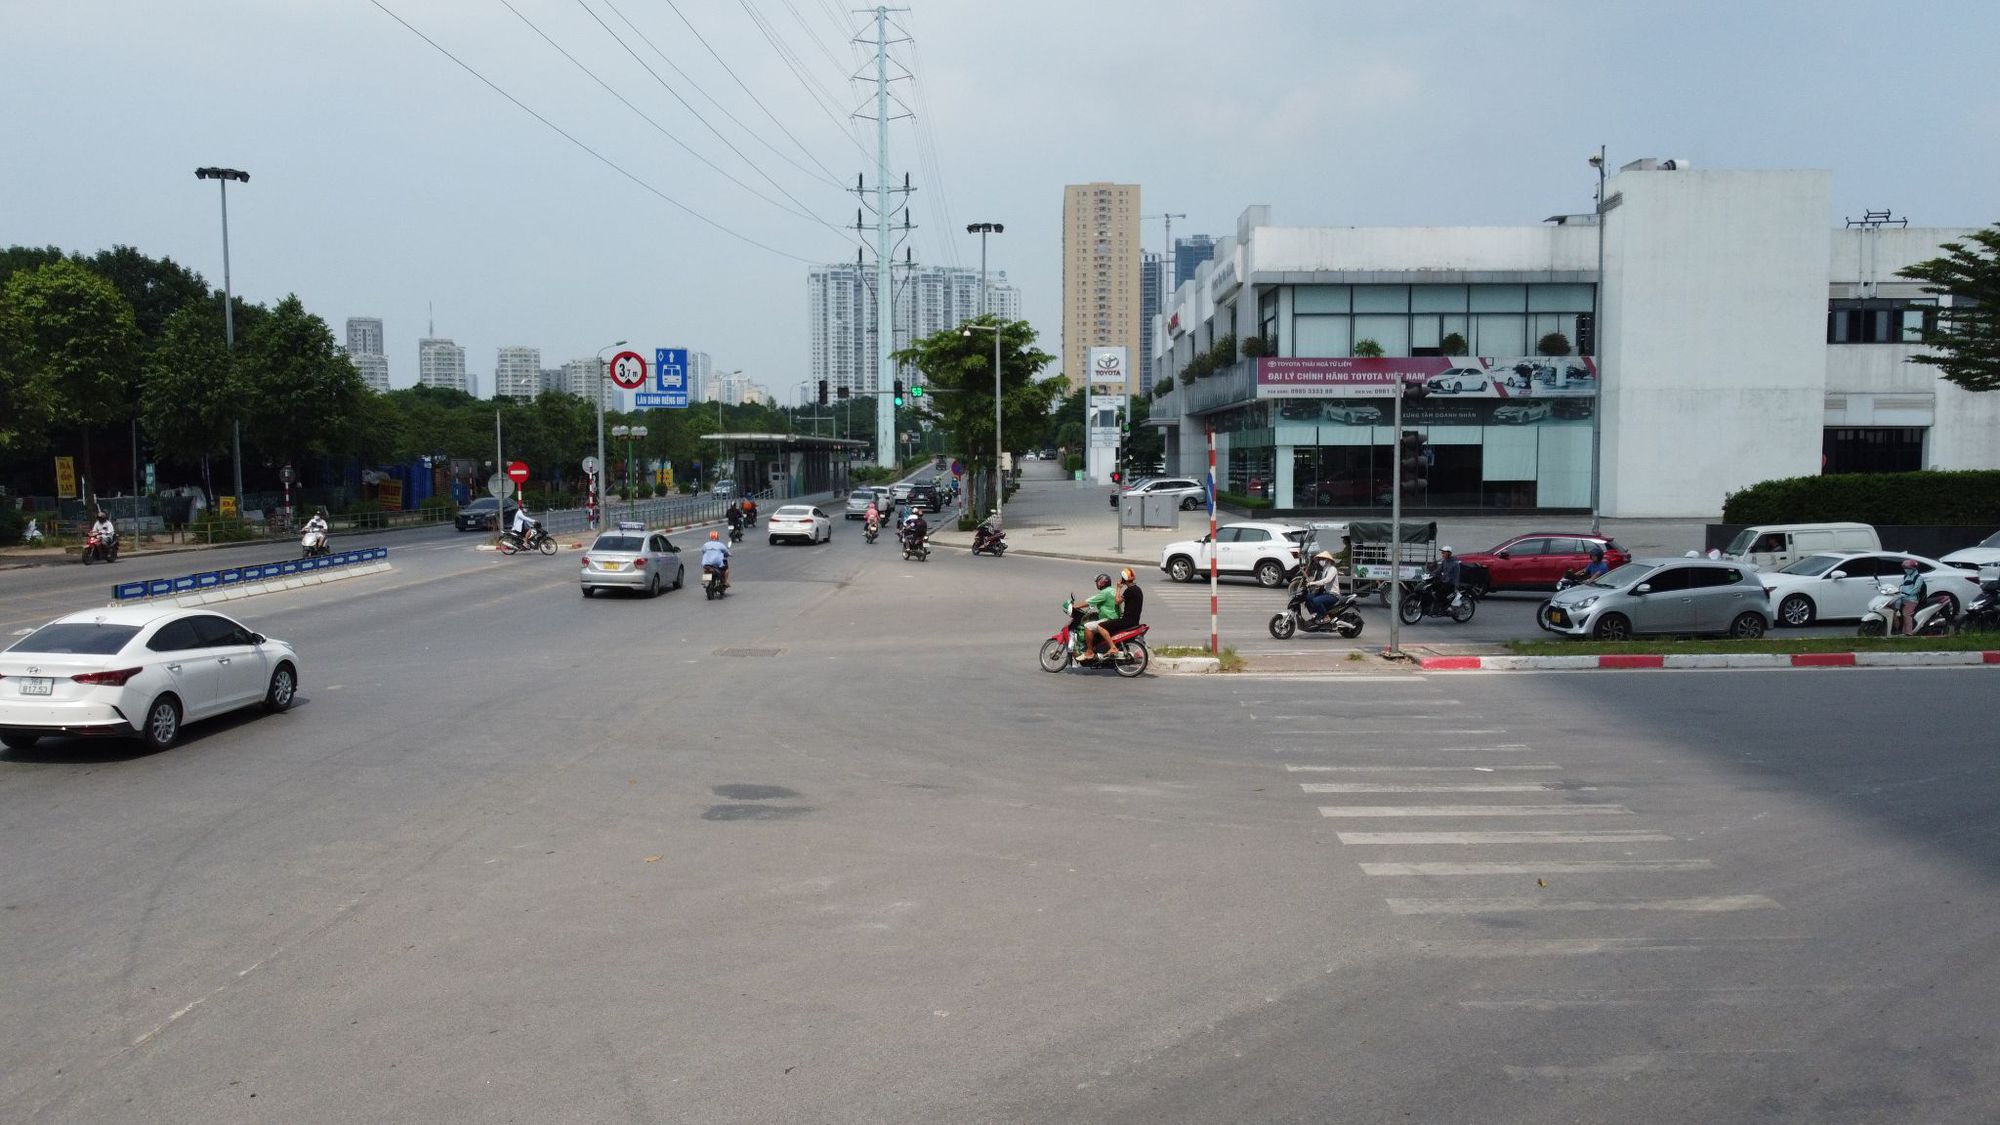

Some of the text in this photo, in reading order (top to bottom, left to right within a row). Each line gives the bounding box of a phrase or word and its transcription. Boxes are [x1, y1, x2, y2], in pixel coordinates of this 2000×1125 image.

[1268, 372, 1282, 381] ĐẠI
[1285, 371, 1294, 380] LÝ
[1297, 371, 1323, 380] CHÍNH
[1326, 371, 1348, 380] HÃNG
[1351, 372, 1382, 380] TOYOTA
[1406, 372, 1425, 380] NAM
